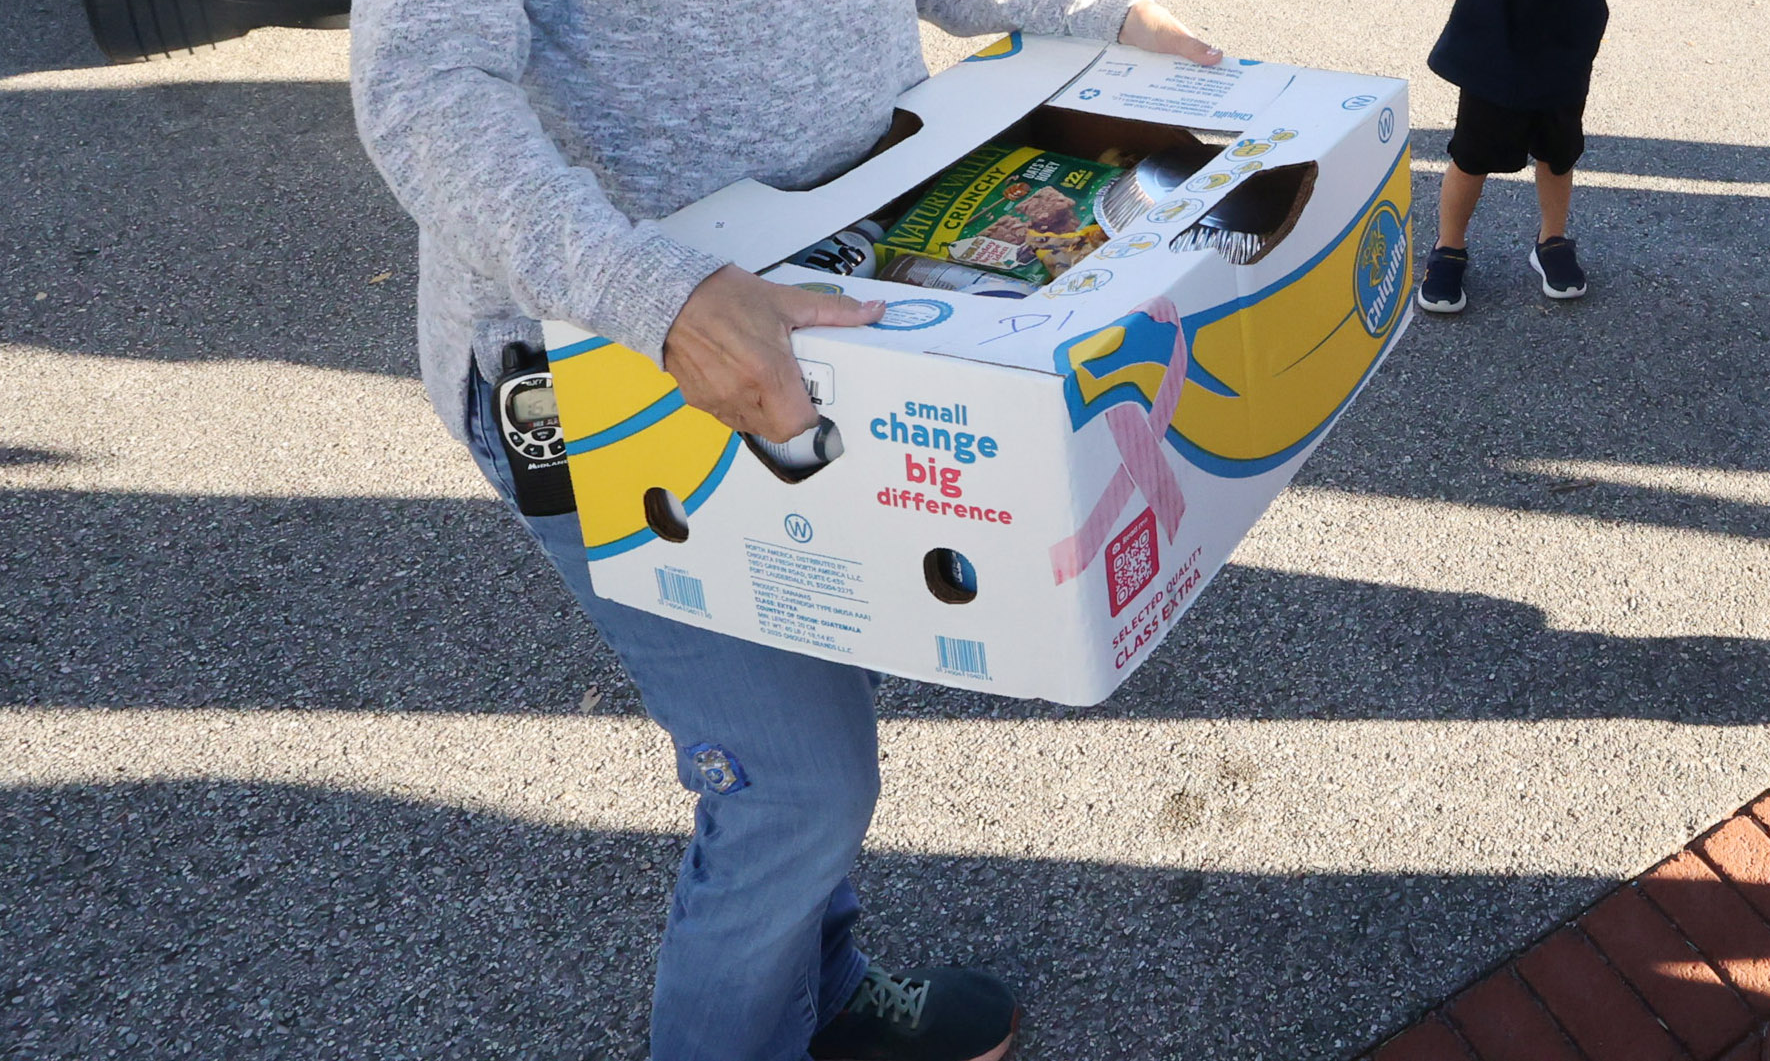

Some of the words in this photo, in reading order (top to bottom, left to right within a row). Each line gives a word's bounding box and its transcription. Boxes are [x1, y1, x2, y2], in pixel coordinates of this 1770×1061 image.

[1022, 162, 1045, 179] OATS
[1034, 161, 1061, 181] HONEY
[891, 179, 953, 251] NATURE
[949, 143, 1014, 189] VALLEY
[945, 167, 1007, 231] CRUNCHY
[1367, 227, 1407, 334] Chiquita
[905, 401, 968, 426] small
[870, 412, 998, 464] change
[905, 453, 962, 498] big
[877, 487, 1012, 524] difference
[1113, 591, 1163, 649] SELECTED
[1166, 545, 1202, 594] QUALITY
[1115, 615, 1159, 669] CLASS
[1162, 568, 1202, 621] EXTRA
[821, 620, 862, 633] GUATEMALA
